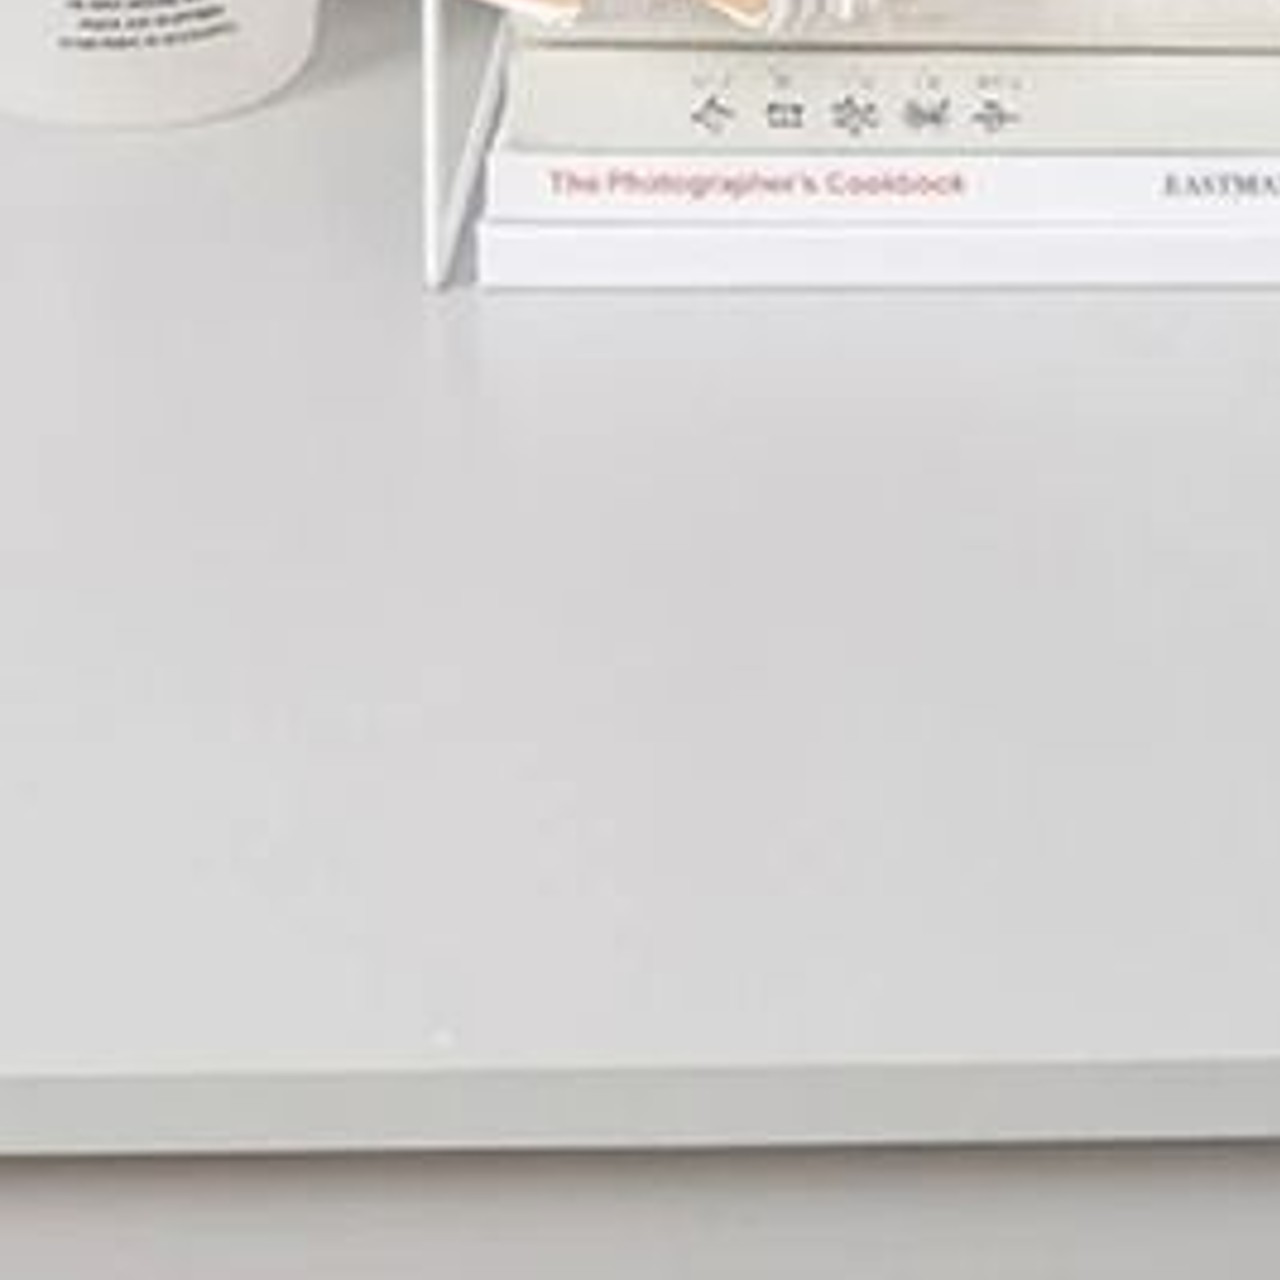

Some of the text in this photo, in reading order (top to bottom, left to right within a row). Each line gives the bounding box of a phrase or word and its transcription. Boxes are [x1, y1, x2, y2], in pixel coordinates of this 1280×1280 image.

[549, 167, 967, 201] The Photographer's Cookbook
